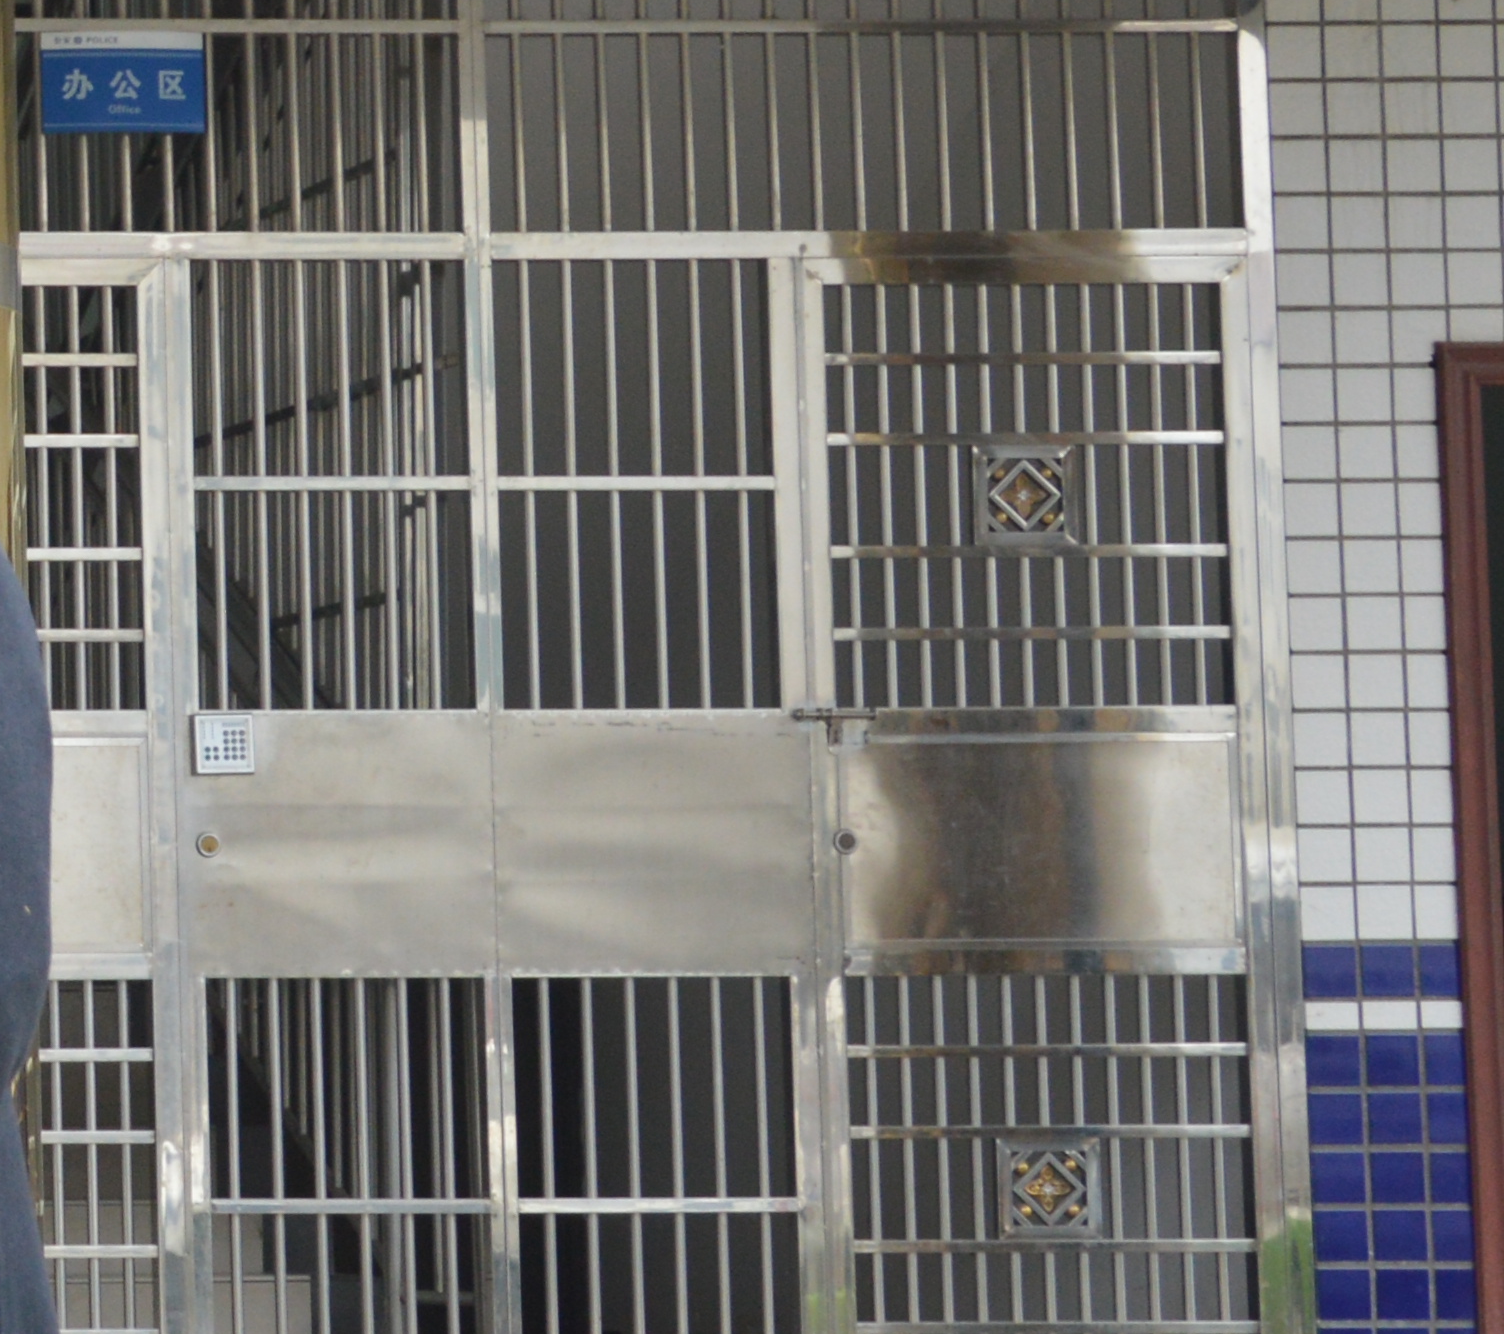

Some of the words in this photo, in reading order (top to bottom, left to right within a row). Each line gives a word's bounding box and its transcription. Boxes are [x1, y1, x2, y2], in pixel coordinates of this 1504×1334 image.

[86, 35, 119, 44] POLICE
[62, 69, 186, 100] 办公区
[108, 104, 142, 115] Office
